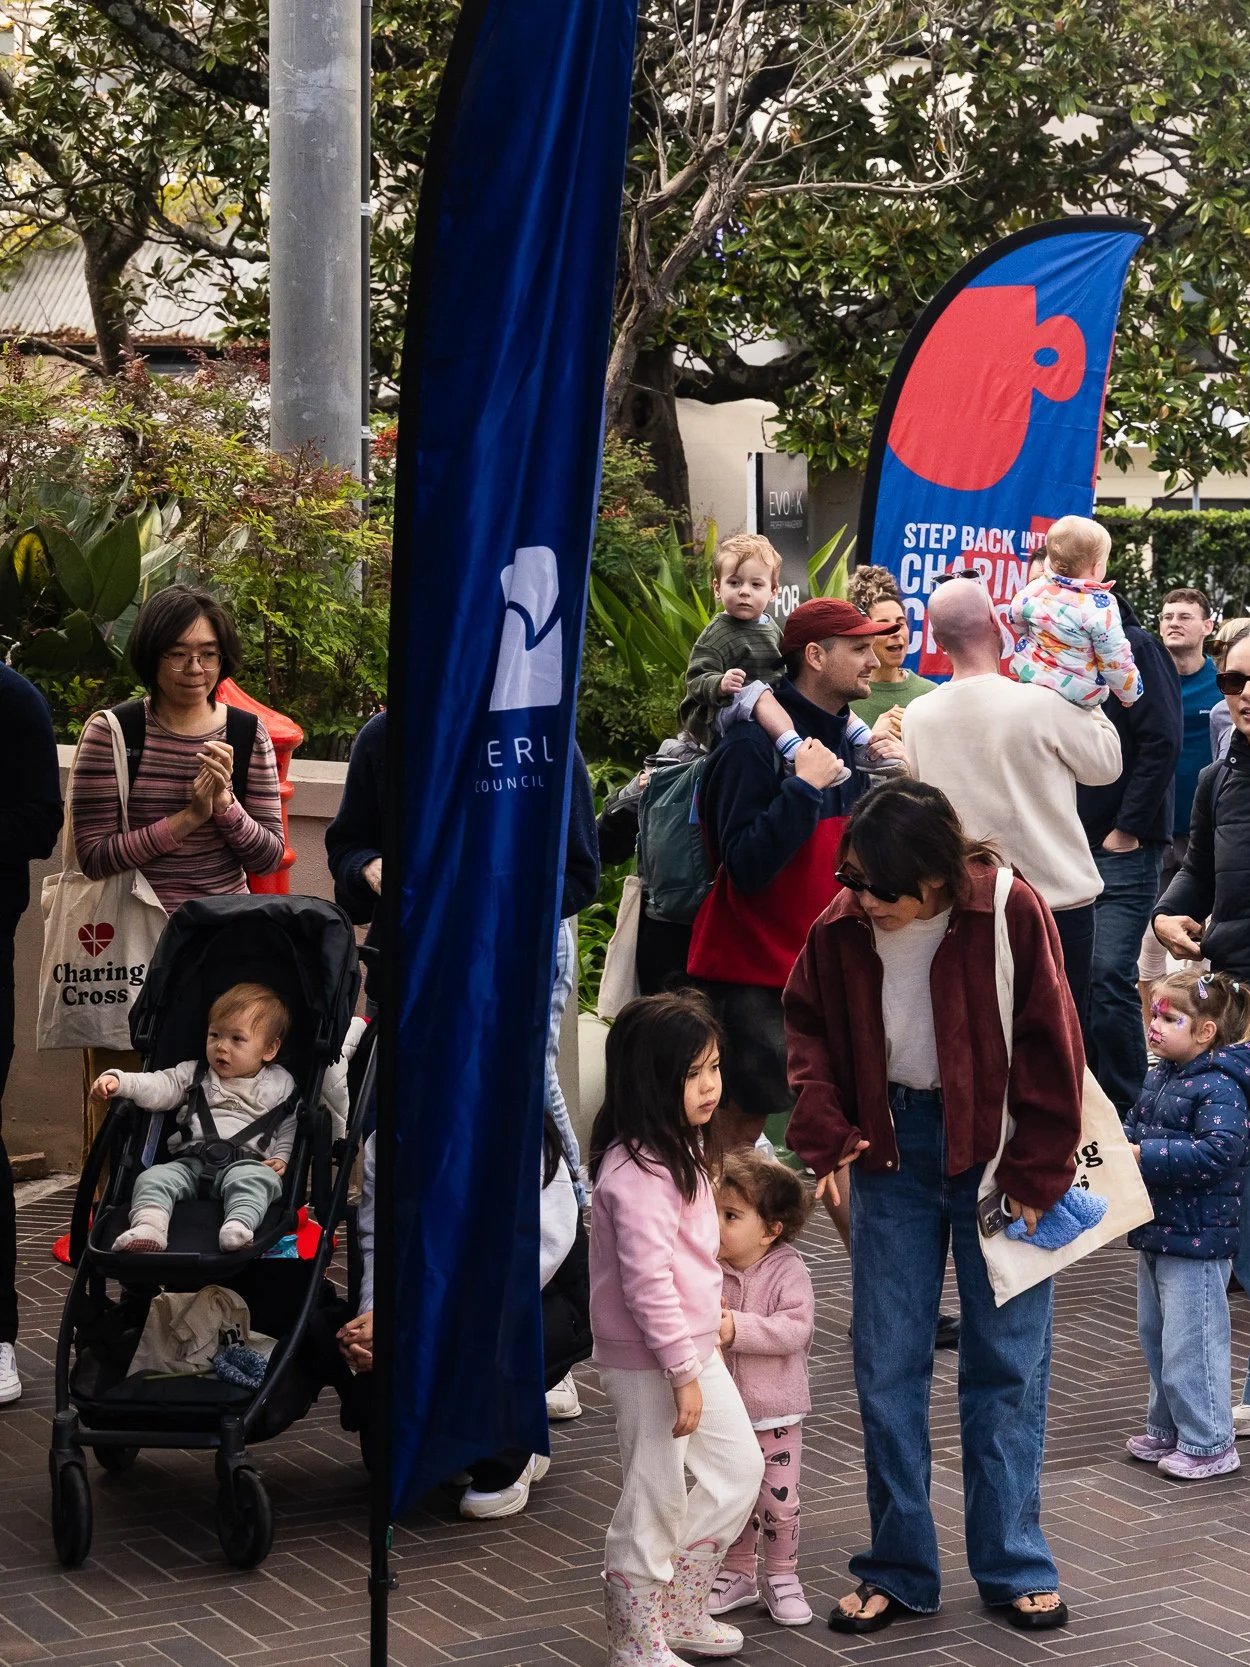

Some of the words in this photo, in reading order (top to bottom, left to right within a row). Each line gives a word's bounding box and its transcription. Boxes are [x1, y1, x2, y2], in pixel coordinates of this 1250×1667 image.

[903, 522, 957, 550] STEP
[960, 525, 1016, 555] BACK
[474, 775, 545, 793] COUNCIL
[52, 961, 145, 986] Charing
[62, 985, 128, 1006] Cross
